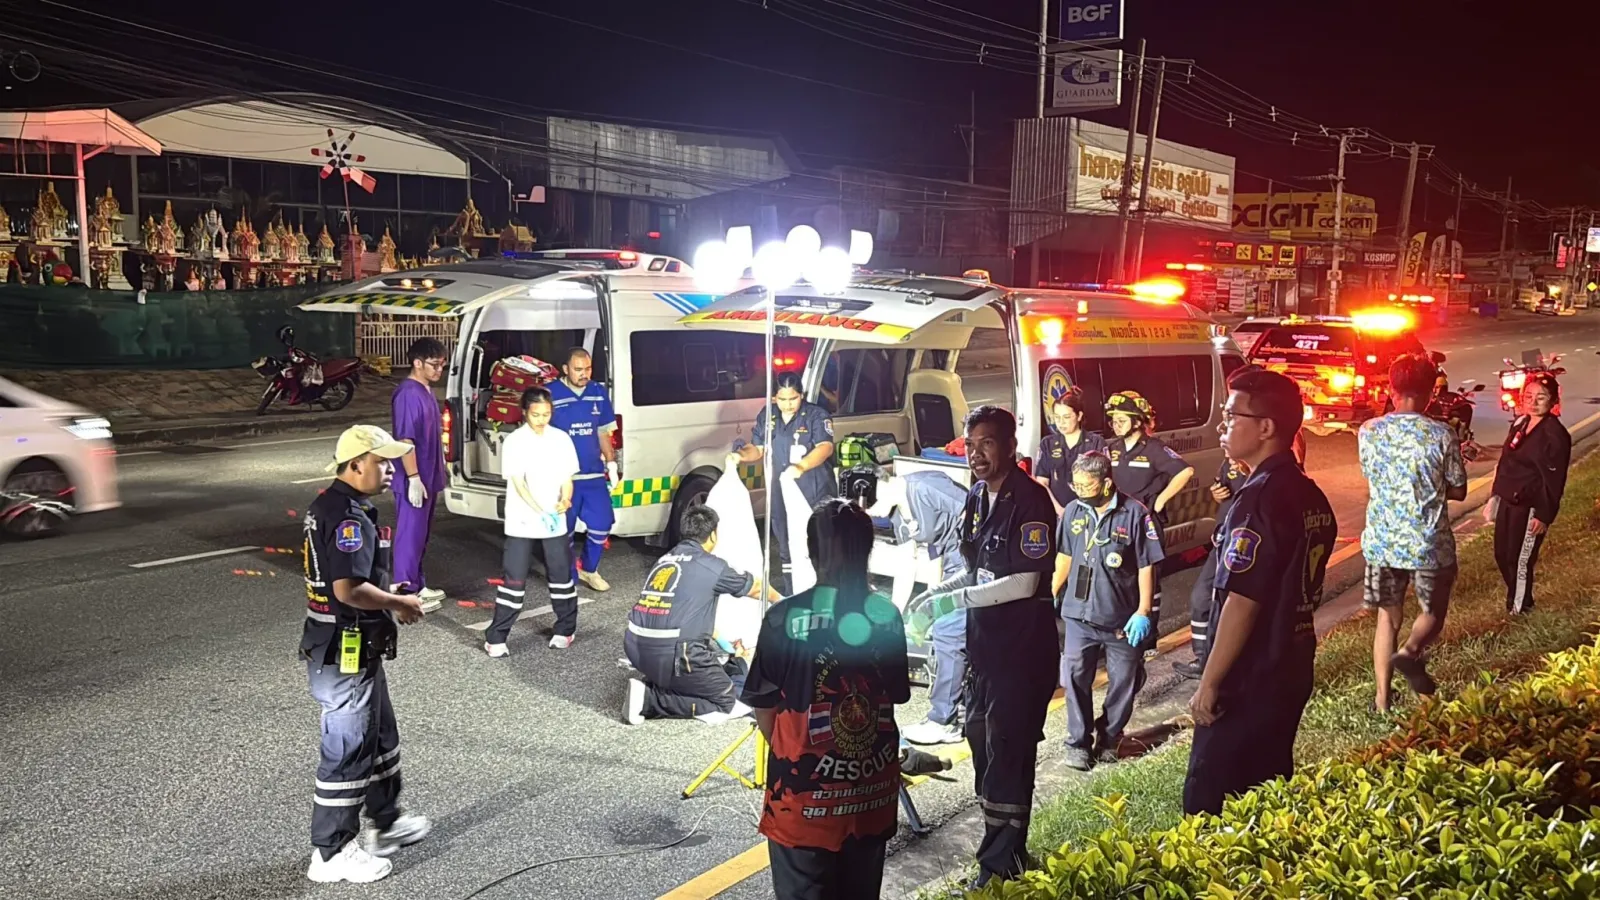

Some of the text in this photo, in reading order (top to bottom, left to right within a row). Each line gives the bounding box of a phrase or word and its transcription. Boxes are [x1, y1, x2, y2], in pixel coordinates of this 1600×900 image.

[1068, 4, 1113, 24] BGF
[1056, 88, 1115, 99] GUARDIAN
[703, 310, 883, 332] AMBULANCE
[1295, 340, 1319, 350] 421
[834, 733, 879, 754] FOUNDATION
[815, 743, 895, 780] RESCUE
